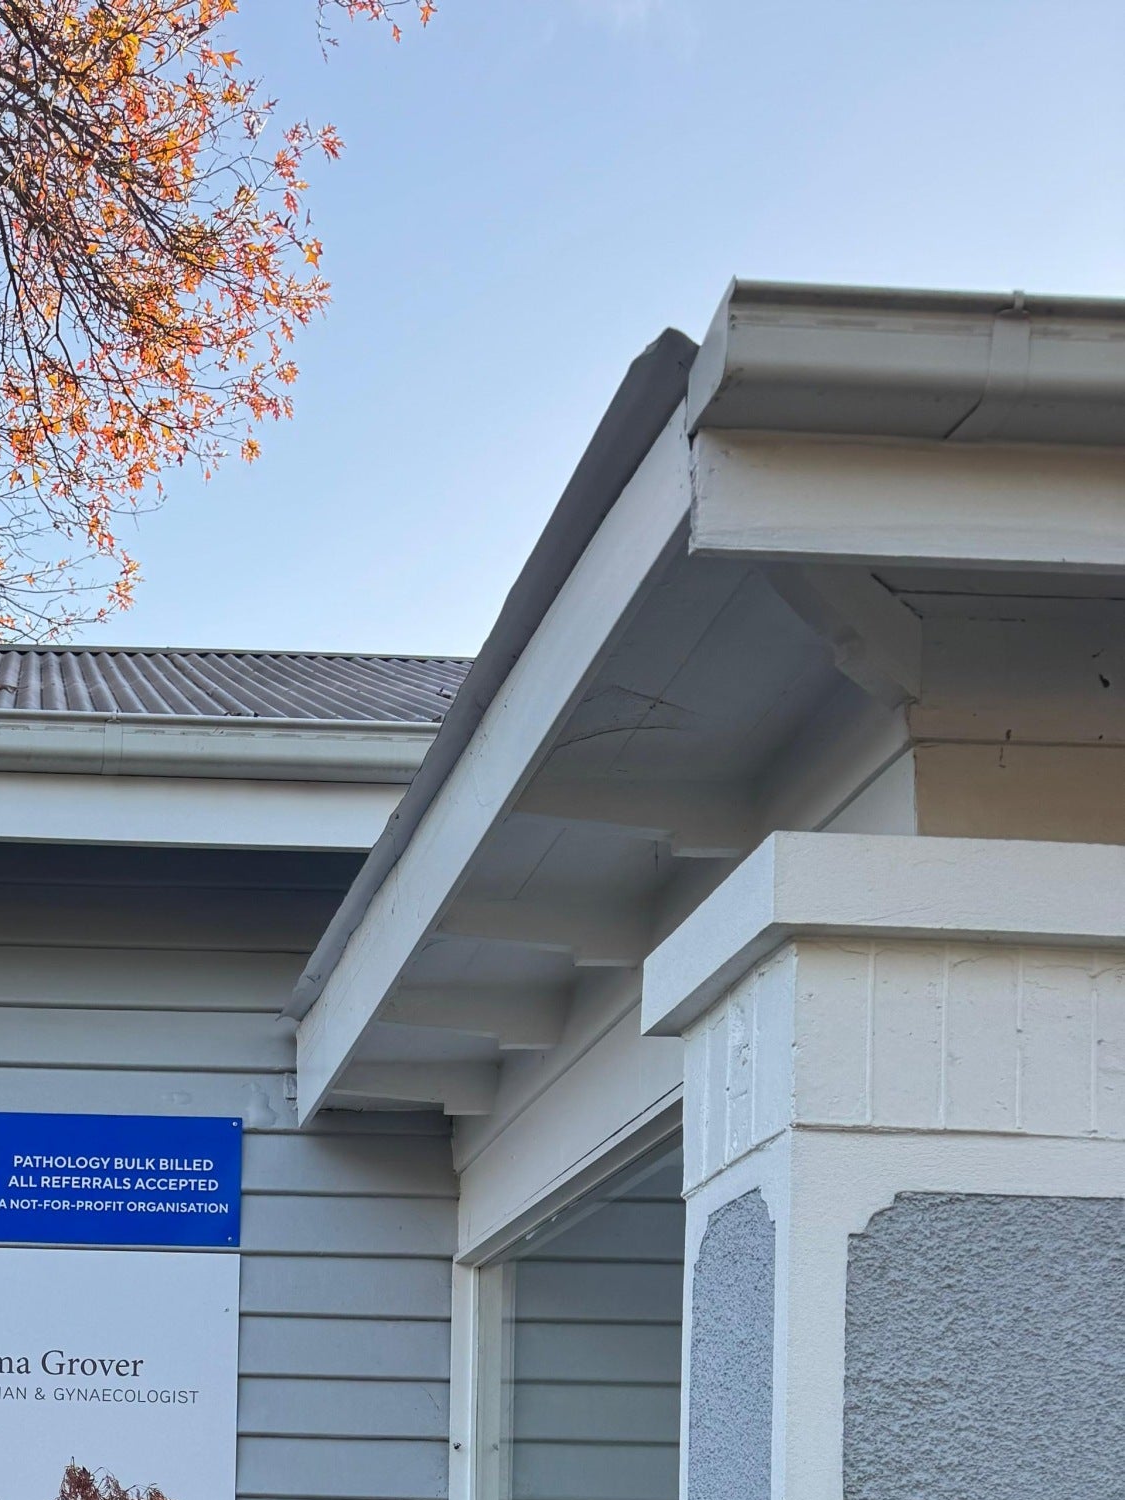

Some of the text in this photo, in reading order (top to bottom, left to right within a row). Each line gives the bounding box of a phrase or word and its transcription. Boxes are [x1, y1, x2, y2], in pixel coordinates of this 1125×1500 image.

[13, 1155, 214, 1171] PATHOLOGY BULK BILLED
[8, 1175, 219, 1191] ALL REFERRALS ACCEPTED
[10, 1199, 124, 1212] NOT-FOR-PROFIT
[126, 1201, 229, 1214] ORGANISATION
[41, 1350, 144, 1377] Grover
[34, 1387, 46, 1401] &
[53, 1388, 199, 1404] GYNAECOLOGIST
